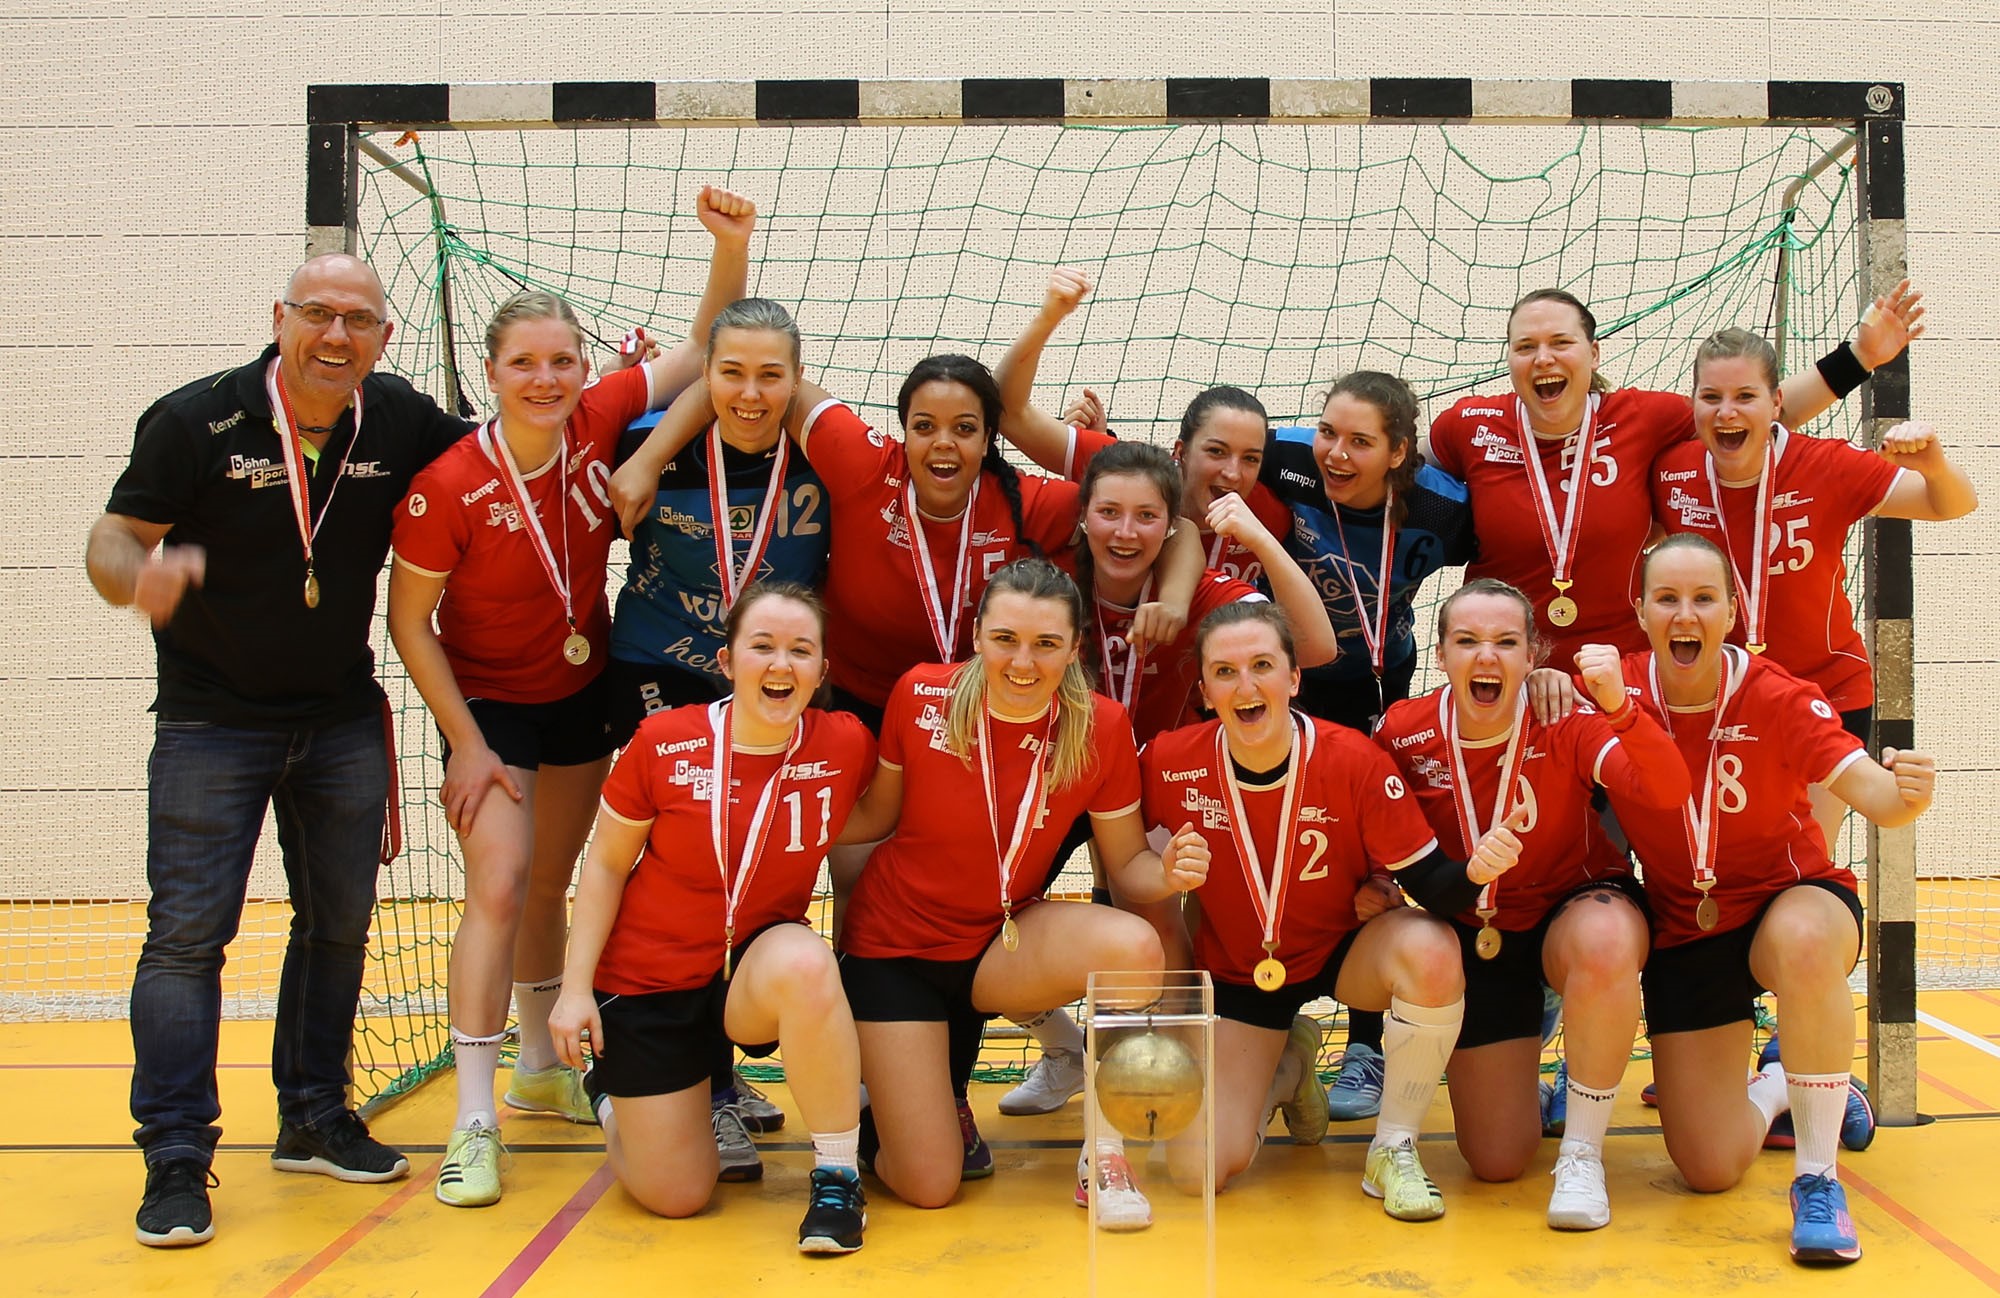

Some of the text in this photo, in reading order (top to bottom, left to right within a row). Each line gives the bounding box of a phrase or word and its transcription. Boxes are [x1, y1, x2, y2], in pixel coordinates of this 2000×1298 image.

[208, 409, 247, 435] Kempa
[1461, 407, 1504, 418] Kempa
[1476, 425, 1507, 445] böhm
[1486, 444, 1520, 461] Sport
[232, 456, 271, 473] böhm
[1560, 436, 1619, 493] 55
[1280, 467, 1317, 488] Kempa
[1660, 470, 1697, 482] Kempa
[461, 478, 500, 506] Kempa
[1670, 487, 1699, 507] böhm
[661, 508, 695, 523] böhm
[775, 483, 822, 538] 12
[1682, 504, 1712, 521] Sport
[732, 531, 752, 540] PAR
[1404, 535, 1435, 580] 6
[656, 736, 708, 757] Kempa
[1392, 728, 1435, 750] Kempa
[780, 760, 829, 779] hsc
[1162, 767, 1208, 783] Kempa
[1717, 753, 1748, 814] 8
[1186, 787, 1222, 808] böhm
[783, 786, 832, 853] 11
[1204, 809, 1230, 826] Spo
[1299, 829, 1329, 881] 2
[1788, 1078, 1848, 1089] Kempa
